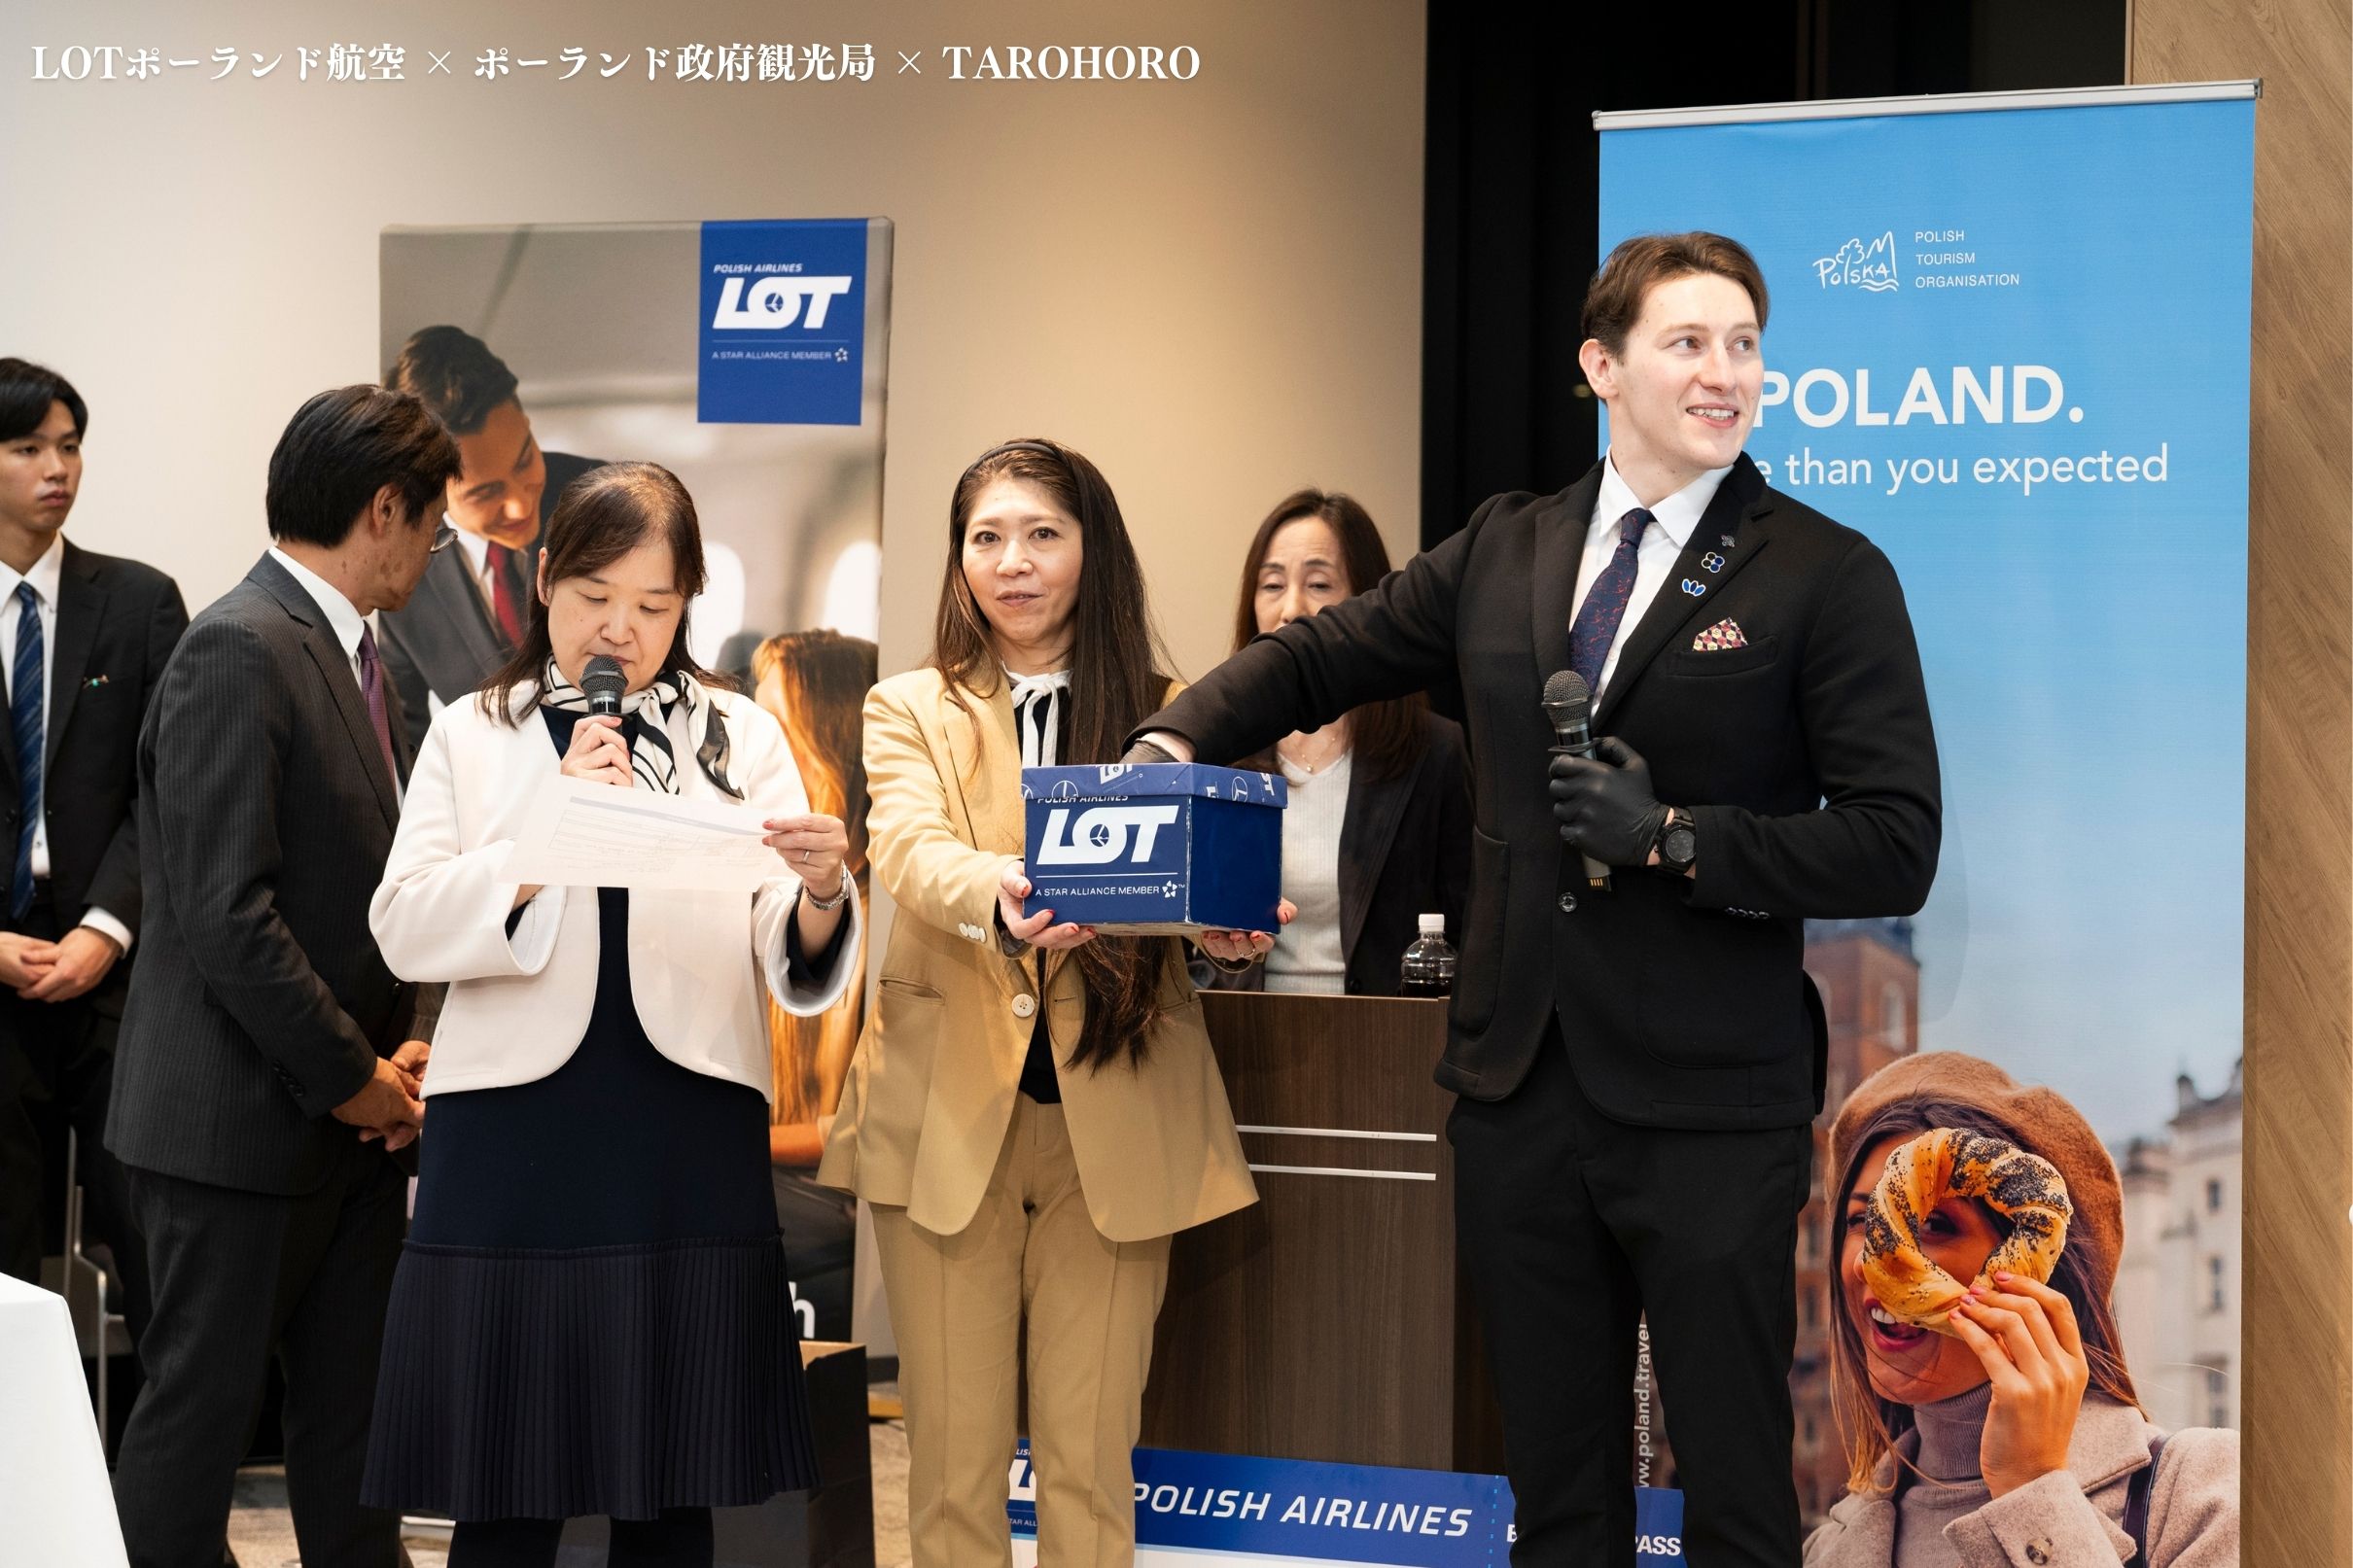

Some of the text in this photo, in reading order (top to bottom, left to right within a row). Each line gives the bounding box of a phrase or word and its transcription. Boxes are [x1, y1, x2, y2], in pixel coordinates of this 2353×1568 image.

[1914, 230, 1965, 243] POLISH
[1915, 253, 1976, 265] TOURISM
[714, 263, 803, 274] POLISH AIRLINES
[1915, 274, 2019, 289] ORGANISATION
[712, 276, 853, 330] LOT
[712, 351, 831, 360] A STAR ALLIANCE MEMBER
[1753, 366, 2085, 428] POLAND.
[1784, 447, 1872, 485] than
[1886, 456, 1959, 496] you
[1973, 442, 2168, 496] expected
[1036, 805, 1179, 865] LOT
[1071, 887, 1116, 896] ALLIANCE
[1118, 886, 1160, 895] MEMBER
[1281, 1495, 1472, 1537] AIRLINES
[1635, 1535, 1681, 1556] ASS
